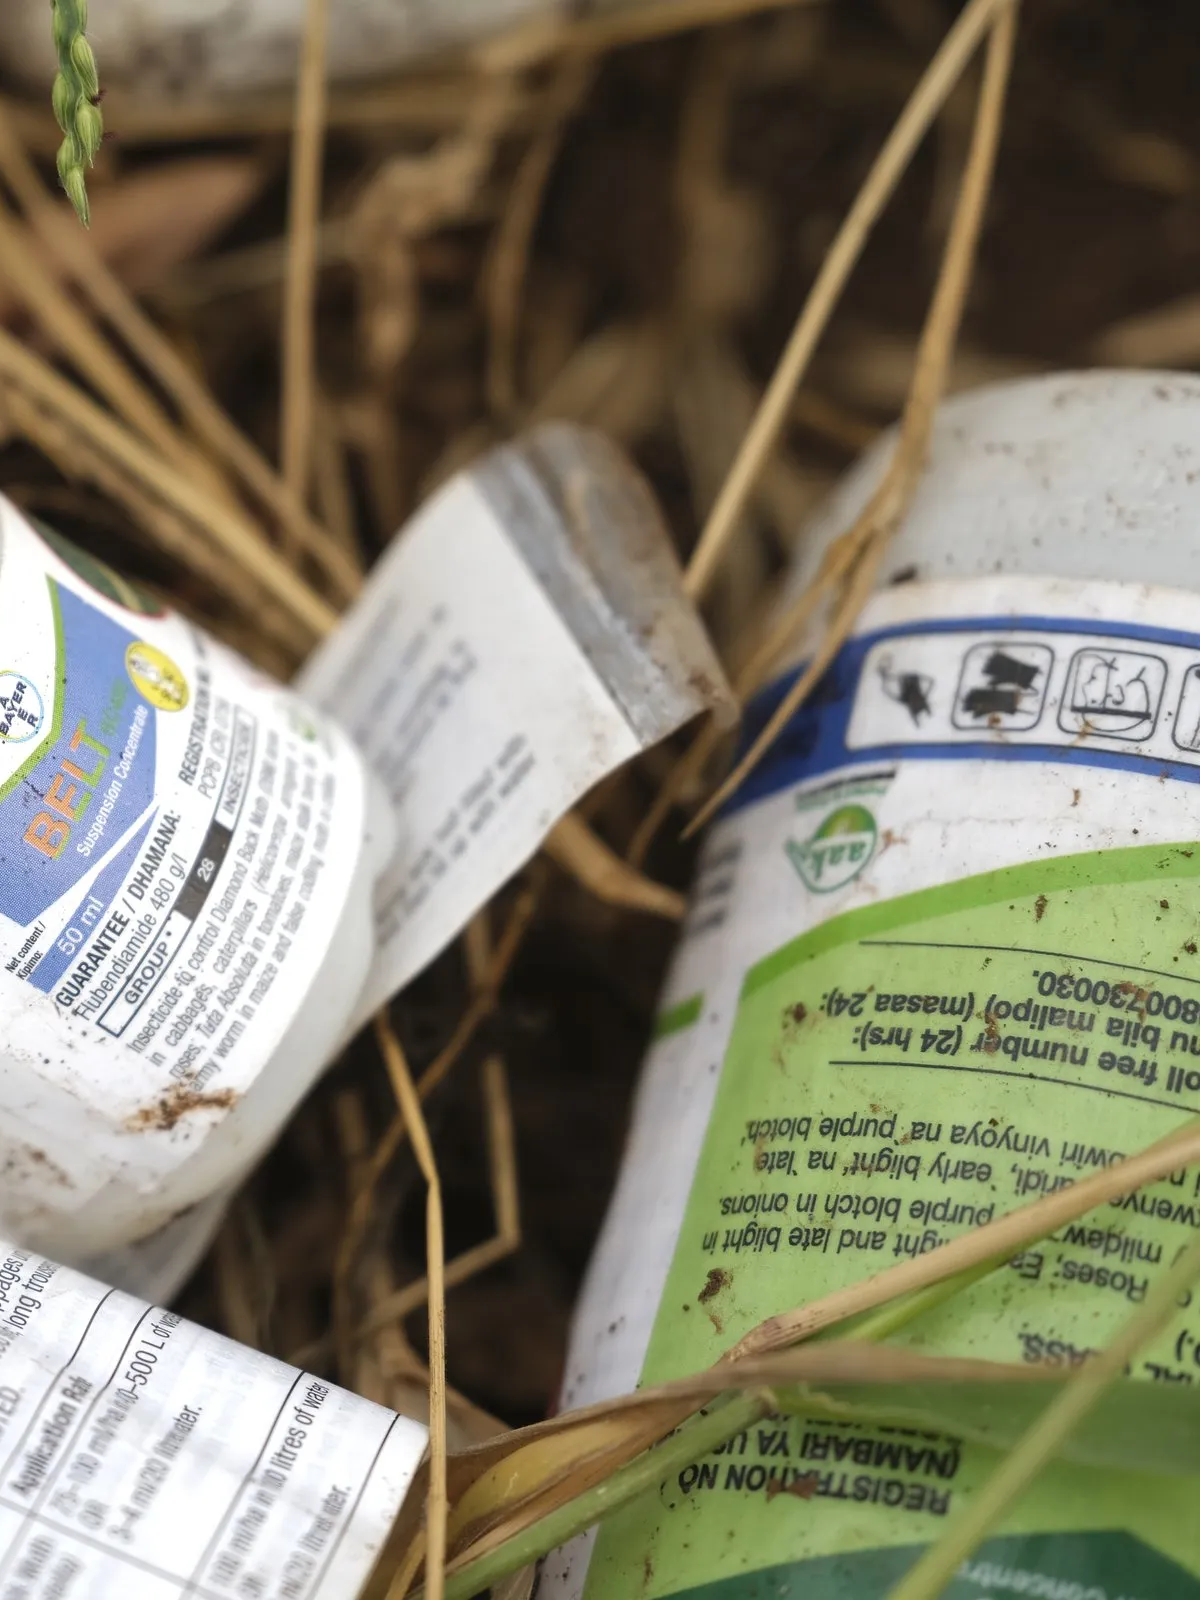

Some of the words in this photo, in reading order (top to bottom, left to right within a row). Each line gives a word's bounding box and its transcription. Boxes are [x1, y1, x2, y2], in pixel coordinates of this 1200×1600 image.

[22, 717, 111, 861] BELT
[77, 778, 123, 857] Suspension
[113, 704, 149, 780] Concentrate
[55, 910, 131, 1008] GUARANTEE
[126, 809, 181, 901] DHAMANA:
[56, 927, 83, 956] 50
[81, 895, 105, 927] ml
[188, 921, 220, 971] control
[211, 859, 248, 923] Diamond
[76, 913, 158, 1021] Flubendiamide
[152, 878, 175, 911] 480
[169, 852, 188, 880] g/l
[124, 941, 169, 1005] GROUP
[197, 857, 216, 884] 28
[5, 957, 21, 973] Net
[18, 927, 44, 959] content
[16, 950, 43, 981] Kipimo:
[148, 1052, 167, 1067] in
[212, 899, 258, 974] caterpillars
[1033, 970, 1200, 1025] 800730030.
[818, 986, 868, 1018] 24):
[874, 991, 976, 1023] (masaa
[984, 993, 1096, 1033] malipo)
[851, 1020, 913, 1052] hrs):
[920, 1024, 963, 1056] (24
[970, 1032, 1090, 1067] number
[1105, 1016, 1161, 1052] bila
[1098, 1051, 1159, 1087] free
[910, 1120, 942, 1142] na
[950, 1121, 1050, 1160] vinyoya
[808, 1151, 837, 1171] na
[796, 1193, 818, 1223] in
[824, 1194, 903, 1223] blotch
[909, 1197, 995, 1227] purple
[702, 1229, 719, 1256] in
[722, 1220, 782, 1254] blight
[788, 1225, 832, 1254] late
[837, 1228, 888, 1255] and
[3, 1295, 42, 1331] long
[141, 1340, 165, 1351] L
[152, 1323, 173, 1339] of
[270, 1427, 307, 1471] litres
[294, 1406, 316, 1426] of
[758, 1430, 790, 1457] YA
